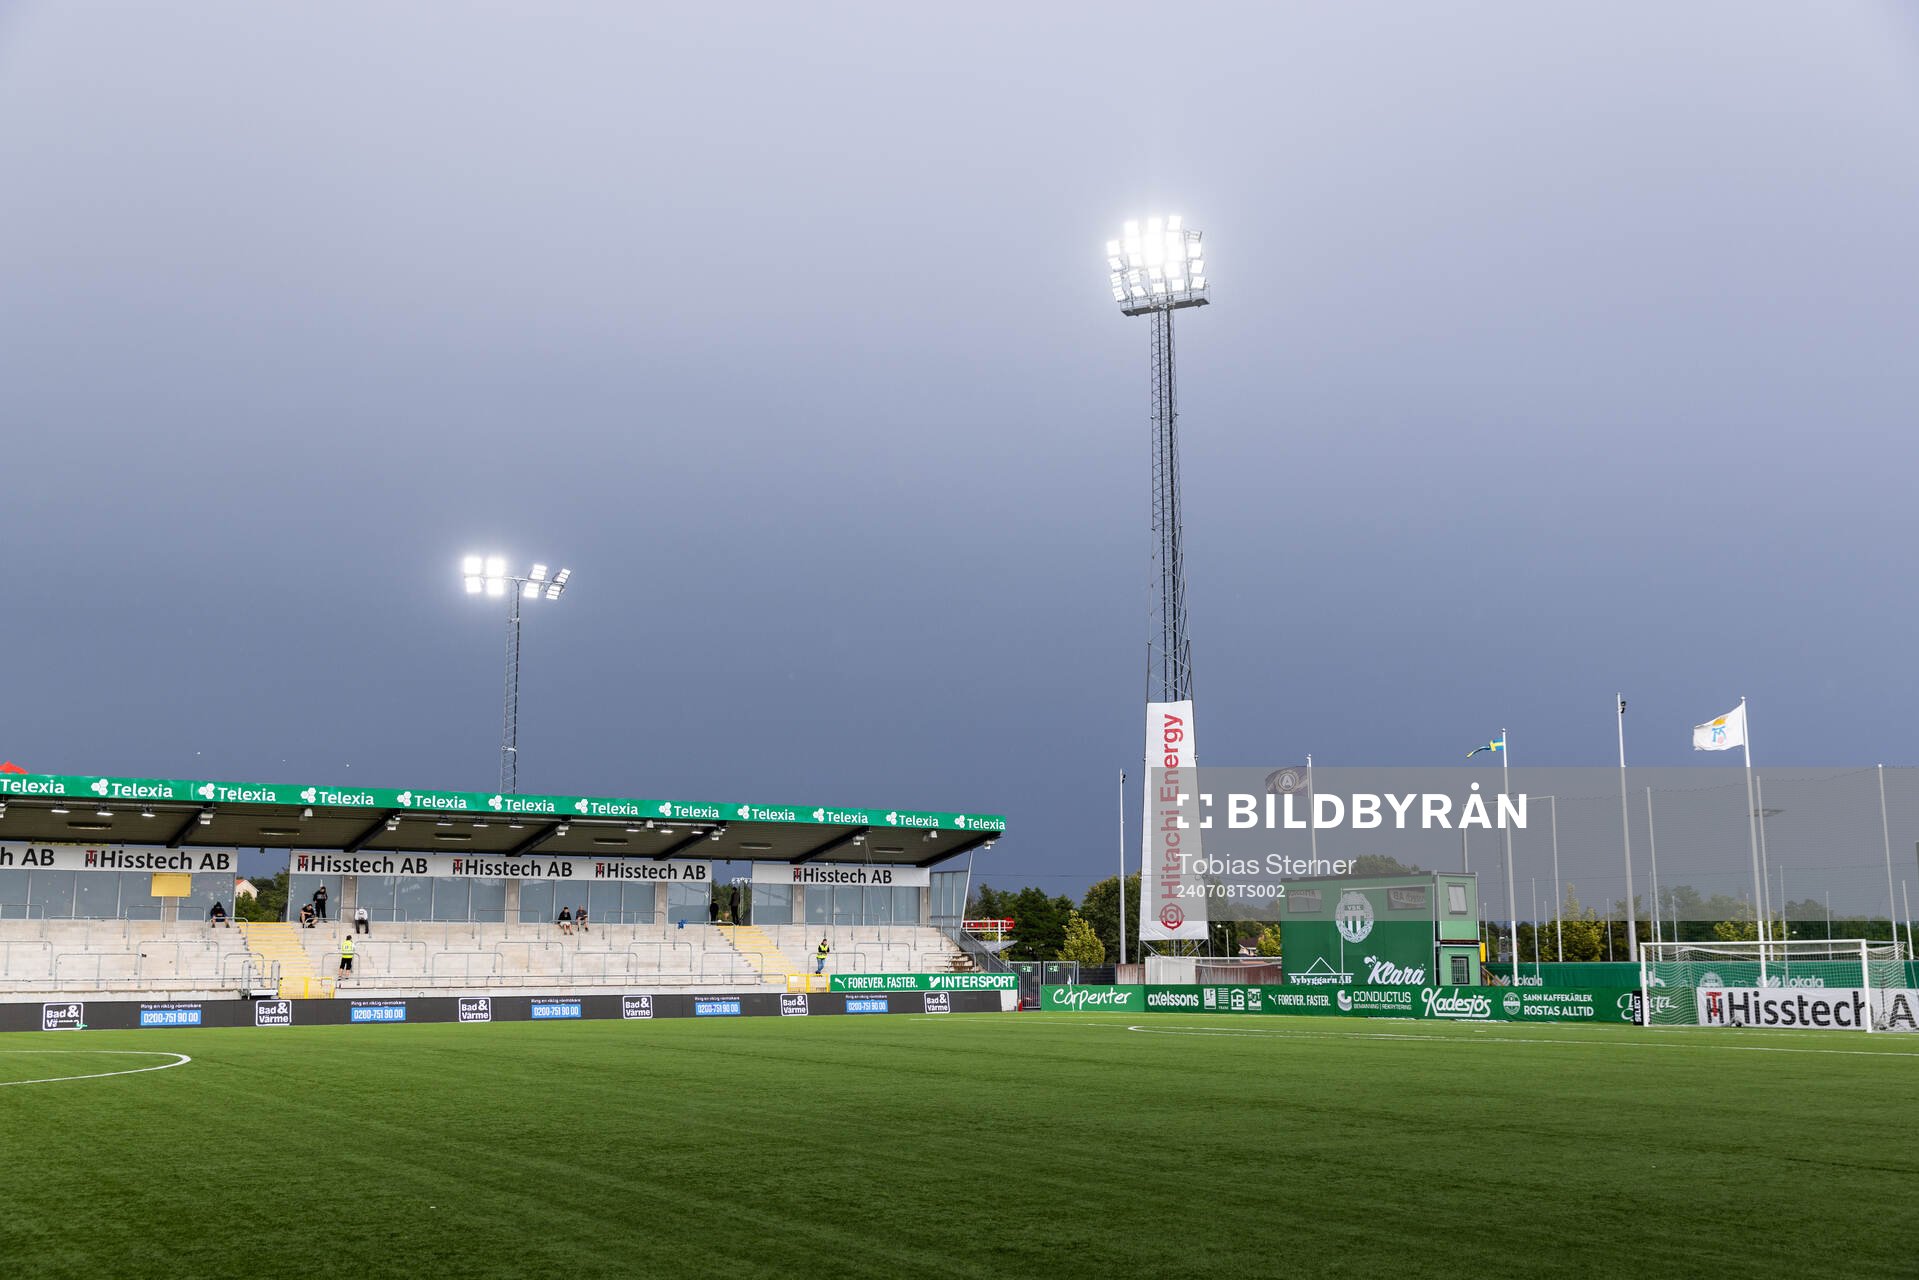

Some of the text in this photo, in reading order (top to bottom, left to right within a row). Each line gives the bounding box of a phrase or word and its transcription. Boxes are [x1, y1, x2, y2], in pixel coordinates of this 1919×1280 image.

[1, 778, 65, 794] Telexia
[112, 783, 173, 798] Telexia
[218, 788, 276, 802] Telexia
[320, 792, 374, 805] Telexia
[415, 795, 467, 809] Telexia
[505, 799, 555, 812] Telexia
[591, 802, 638, 815] Telexia
[1160, 714, 1184, 899] Hitachi Energy
[674, 806, 720, 818] Telexia
[752, 808, 796, 821] Telexia
[826, 812, 868, 824] Telexia
[899, 814, 940, 827] Telexia
[967, 818, 1006, 830] Telexia
[21, 848, 55, 866] AB
[100, 851, 192, 870] Hisstech
[200, 853, 230, 870] AB
[312, 856, 394, 873] Hisstech
[400, 858, 428, 874] AB
[466, 859, 541, 876] Hisstech
[546, 862, 572, 876] AB
[607, 863, 677, 880] Hisstech
[679, 865, 706, 880] AB
[803, 868, 866, 884] Hisstech
[871, 870, 892, 884] AB
[1368, 960, 1426, 986] Klara
[848, 976, 918, 989] FOREVER. FASTER.
[941, 976, 1014, 988] INTERSPORT
[1338, 976, 1352, 984] AB
[641, 997, 650, 1008] &
[797, 996, 806, 1006] &
[940, 994, 948, 1004] &
[1053, 988, 1132, 1010] Carpenter
[1148, 990, 1198, 1007] axelssons
[1278, 994, 1331, 1006] FOREVER. FASTER.
[1353, 991, 1412, 1002] CONDUCTUS
[46, 1005, 80, 1018] Bad &
[258, 1002, 288, 1014] Bad &
[462, 999, 488, 1012] Bad &
[1524, 1006, 1594, 1016] ROSTAS ALLTID
[1634, 996, 1642, 1022] SELECT
[1728, 991, 1867, 1027] Hisstech
[144, 1012, 176, 1023] 0200-751
[188, 1012, 198, 1022] 00
[259, 1014, 288, 1023] Värme
[354, 1009, 403, 1020] 0200-751 90 00
[462, 1011, 488, 1020] Värme
